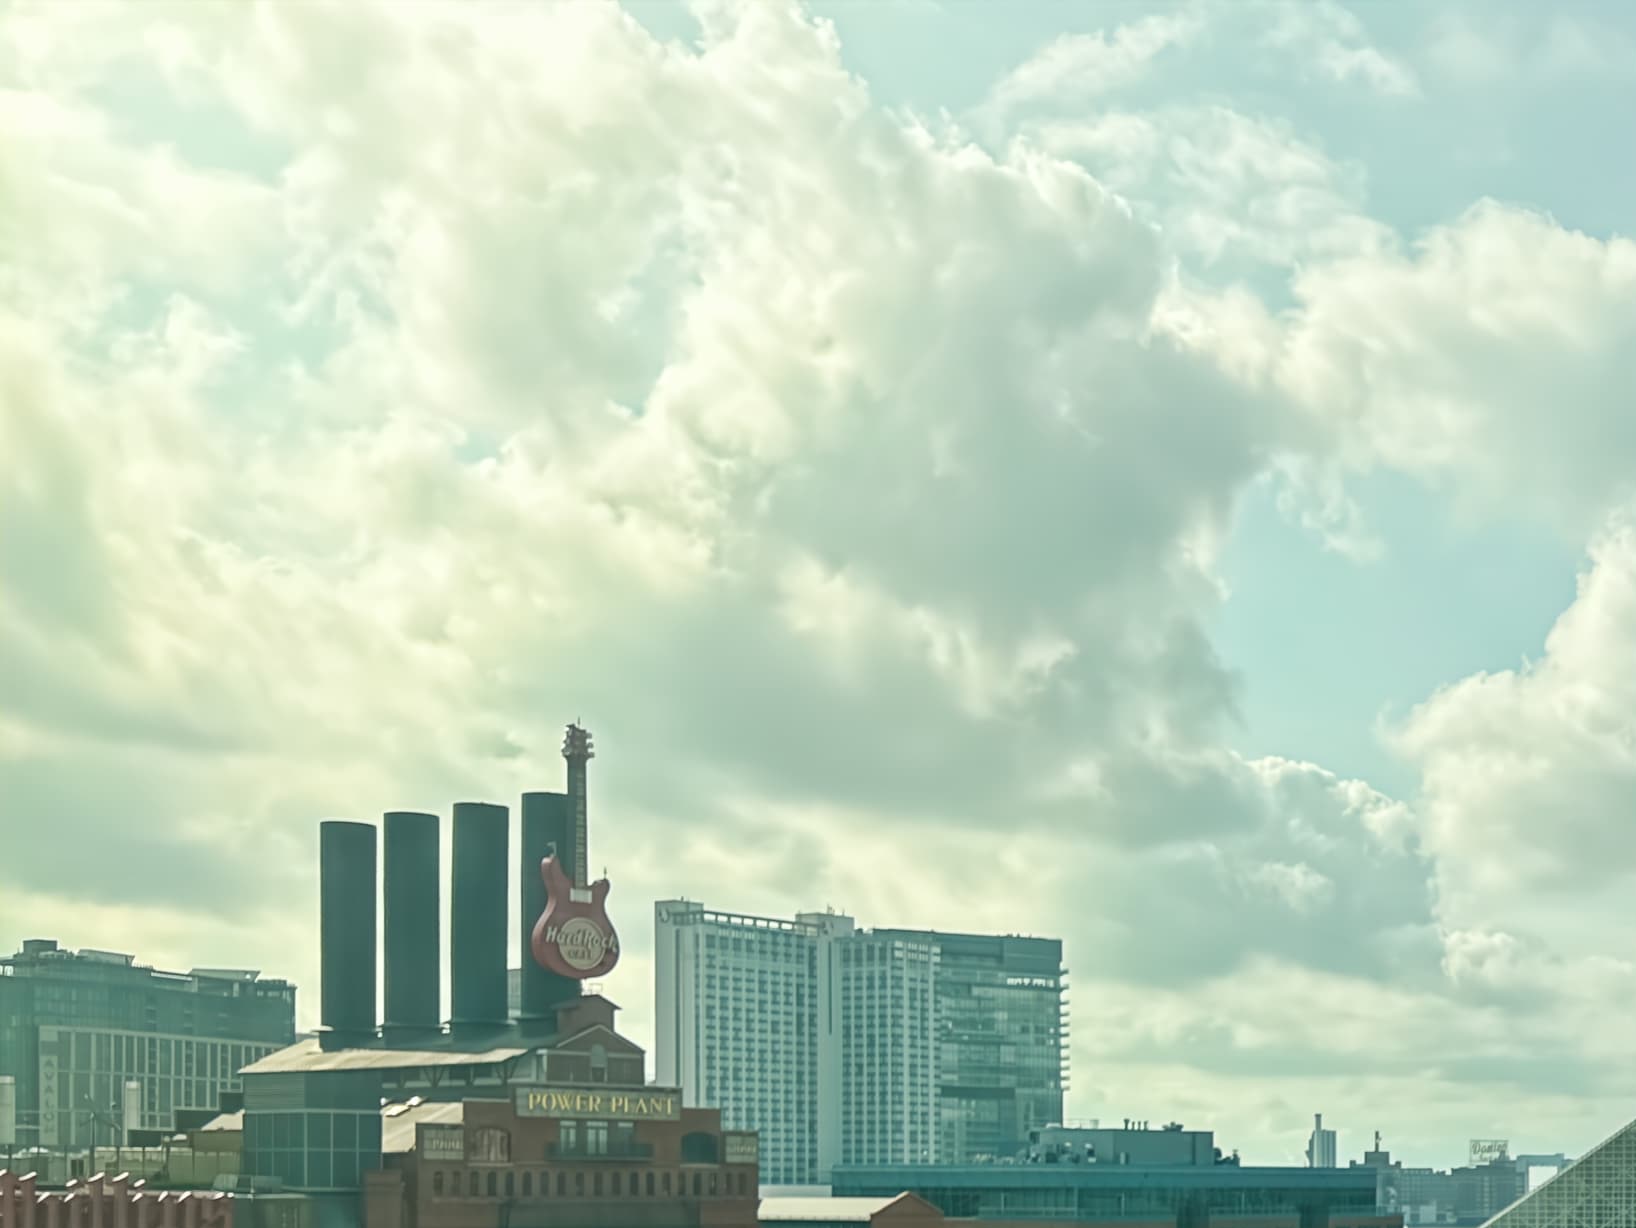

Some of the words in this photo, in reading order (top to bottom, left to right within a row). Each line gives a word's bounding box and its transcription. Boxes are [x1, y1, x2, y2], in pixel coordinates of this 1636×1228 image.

[545, 926, 583, 946] Hard
[527, 1092, 602, 1112] POWER
[610, 1093, 674, 1115] PLANT
